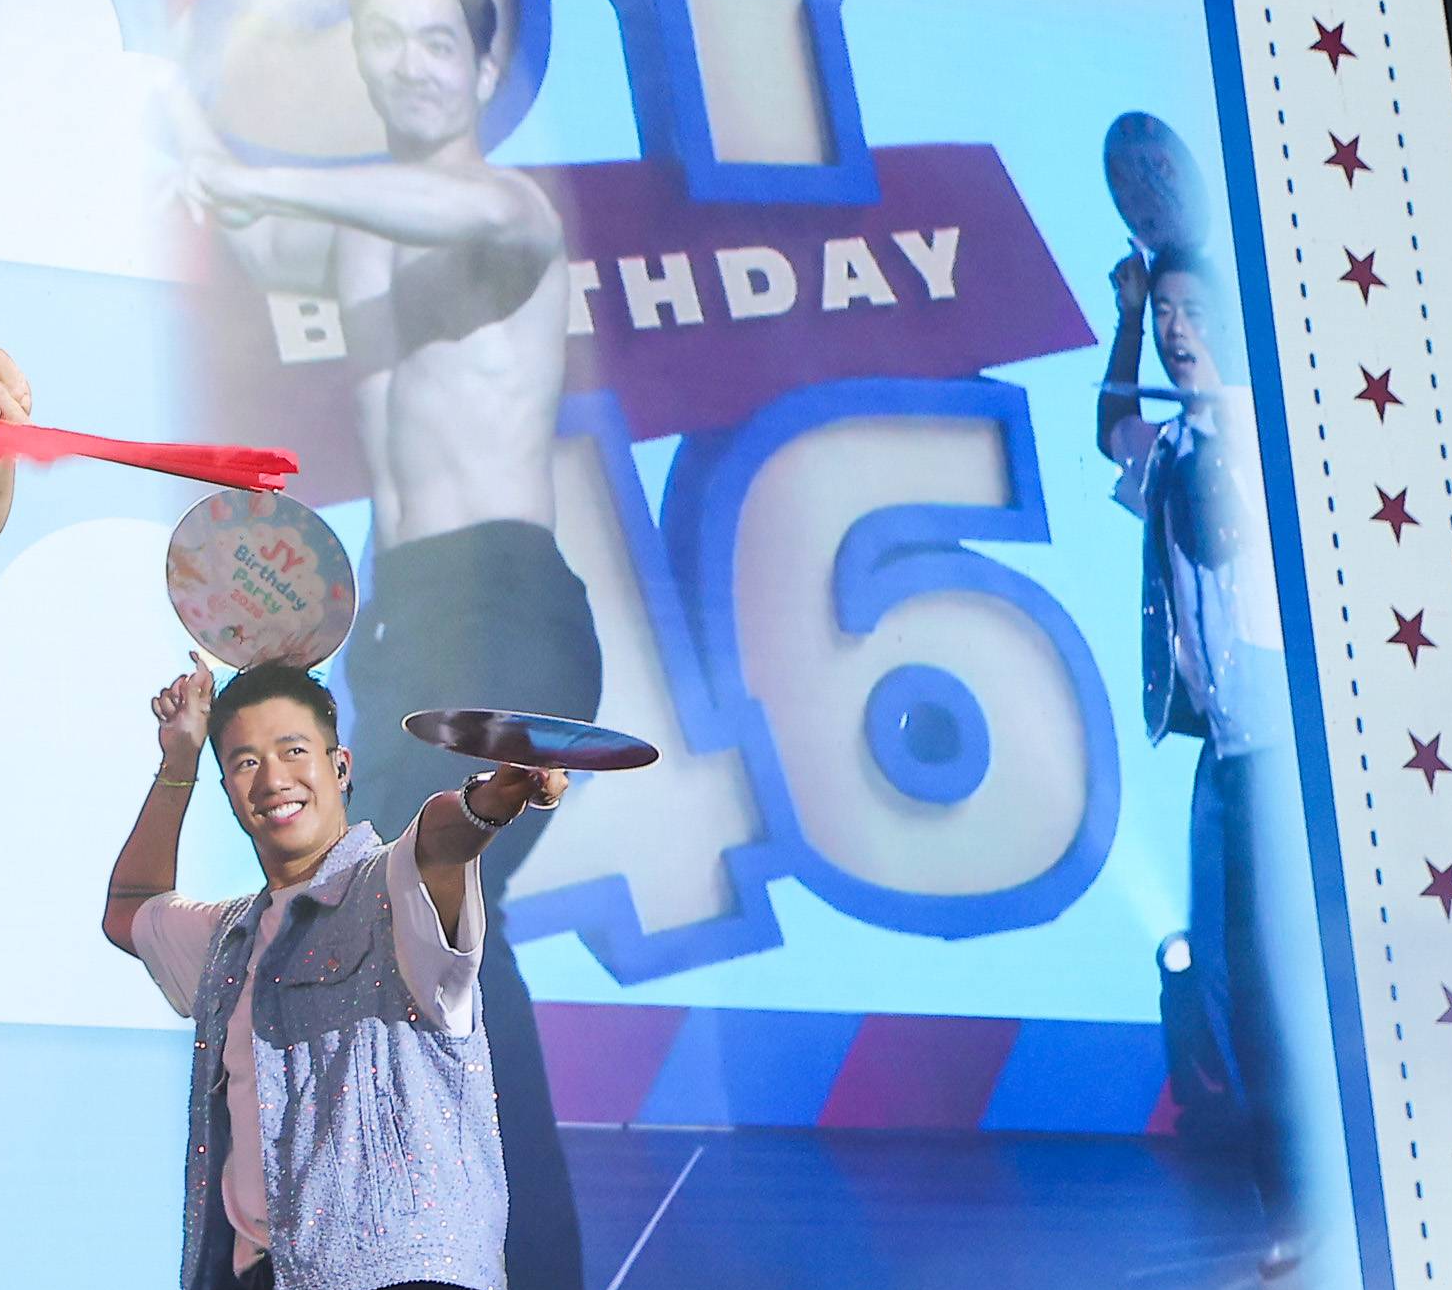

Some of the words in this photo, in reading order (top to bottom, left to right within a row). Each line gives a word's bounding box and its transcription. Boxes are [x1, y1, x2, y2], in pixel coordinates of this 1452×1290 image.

[266, 226, 961, 365] BTHDAY
[233, 543, 307, 611] Birthday
[259, 539, 305, 574] JY
[232, 567, 282, 614] Party
